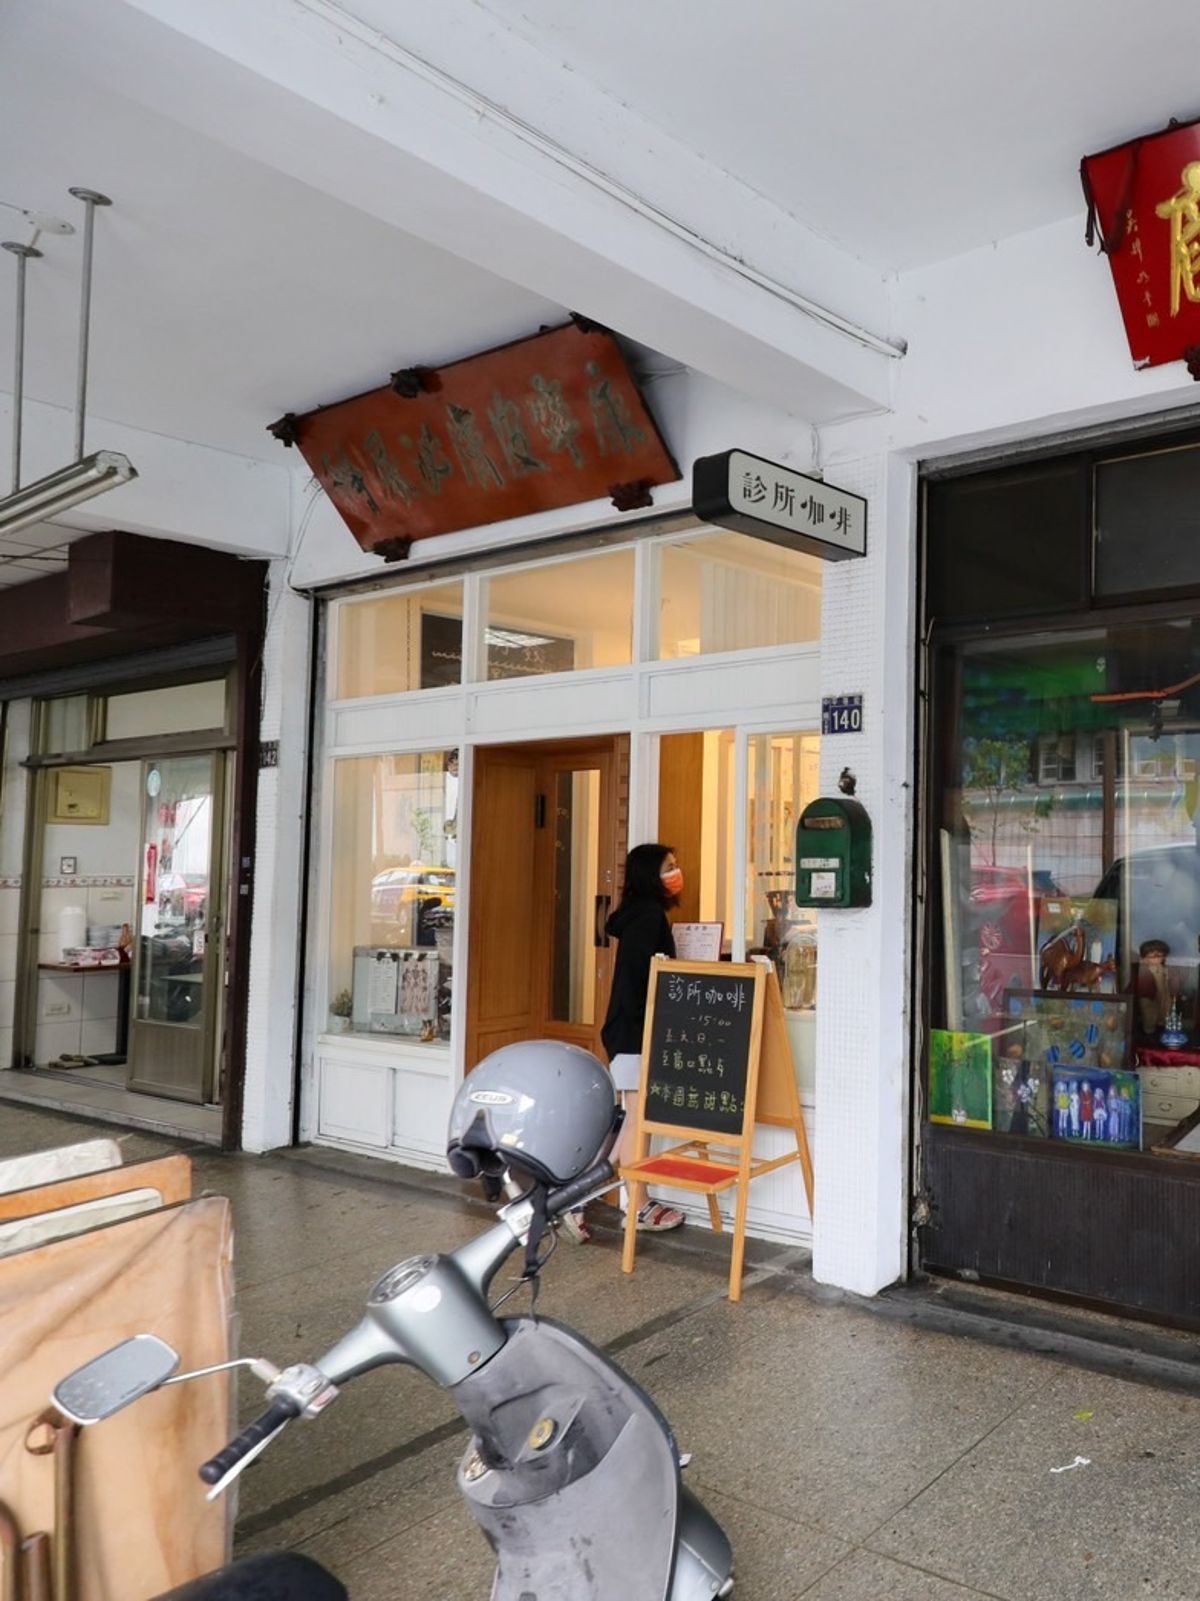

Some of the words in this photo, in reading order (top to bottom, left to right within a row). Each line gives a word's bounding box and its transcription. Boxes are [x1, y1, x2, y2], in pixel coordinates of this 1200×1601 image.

[742, 472, 853, 536] 診所咖啡
[832, 709, 861, 731] 140
[668, 974, 746, 1012] 診所咖啡
